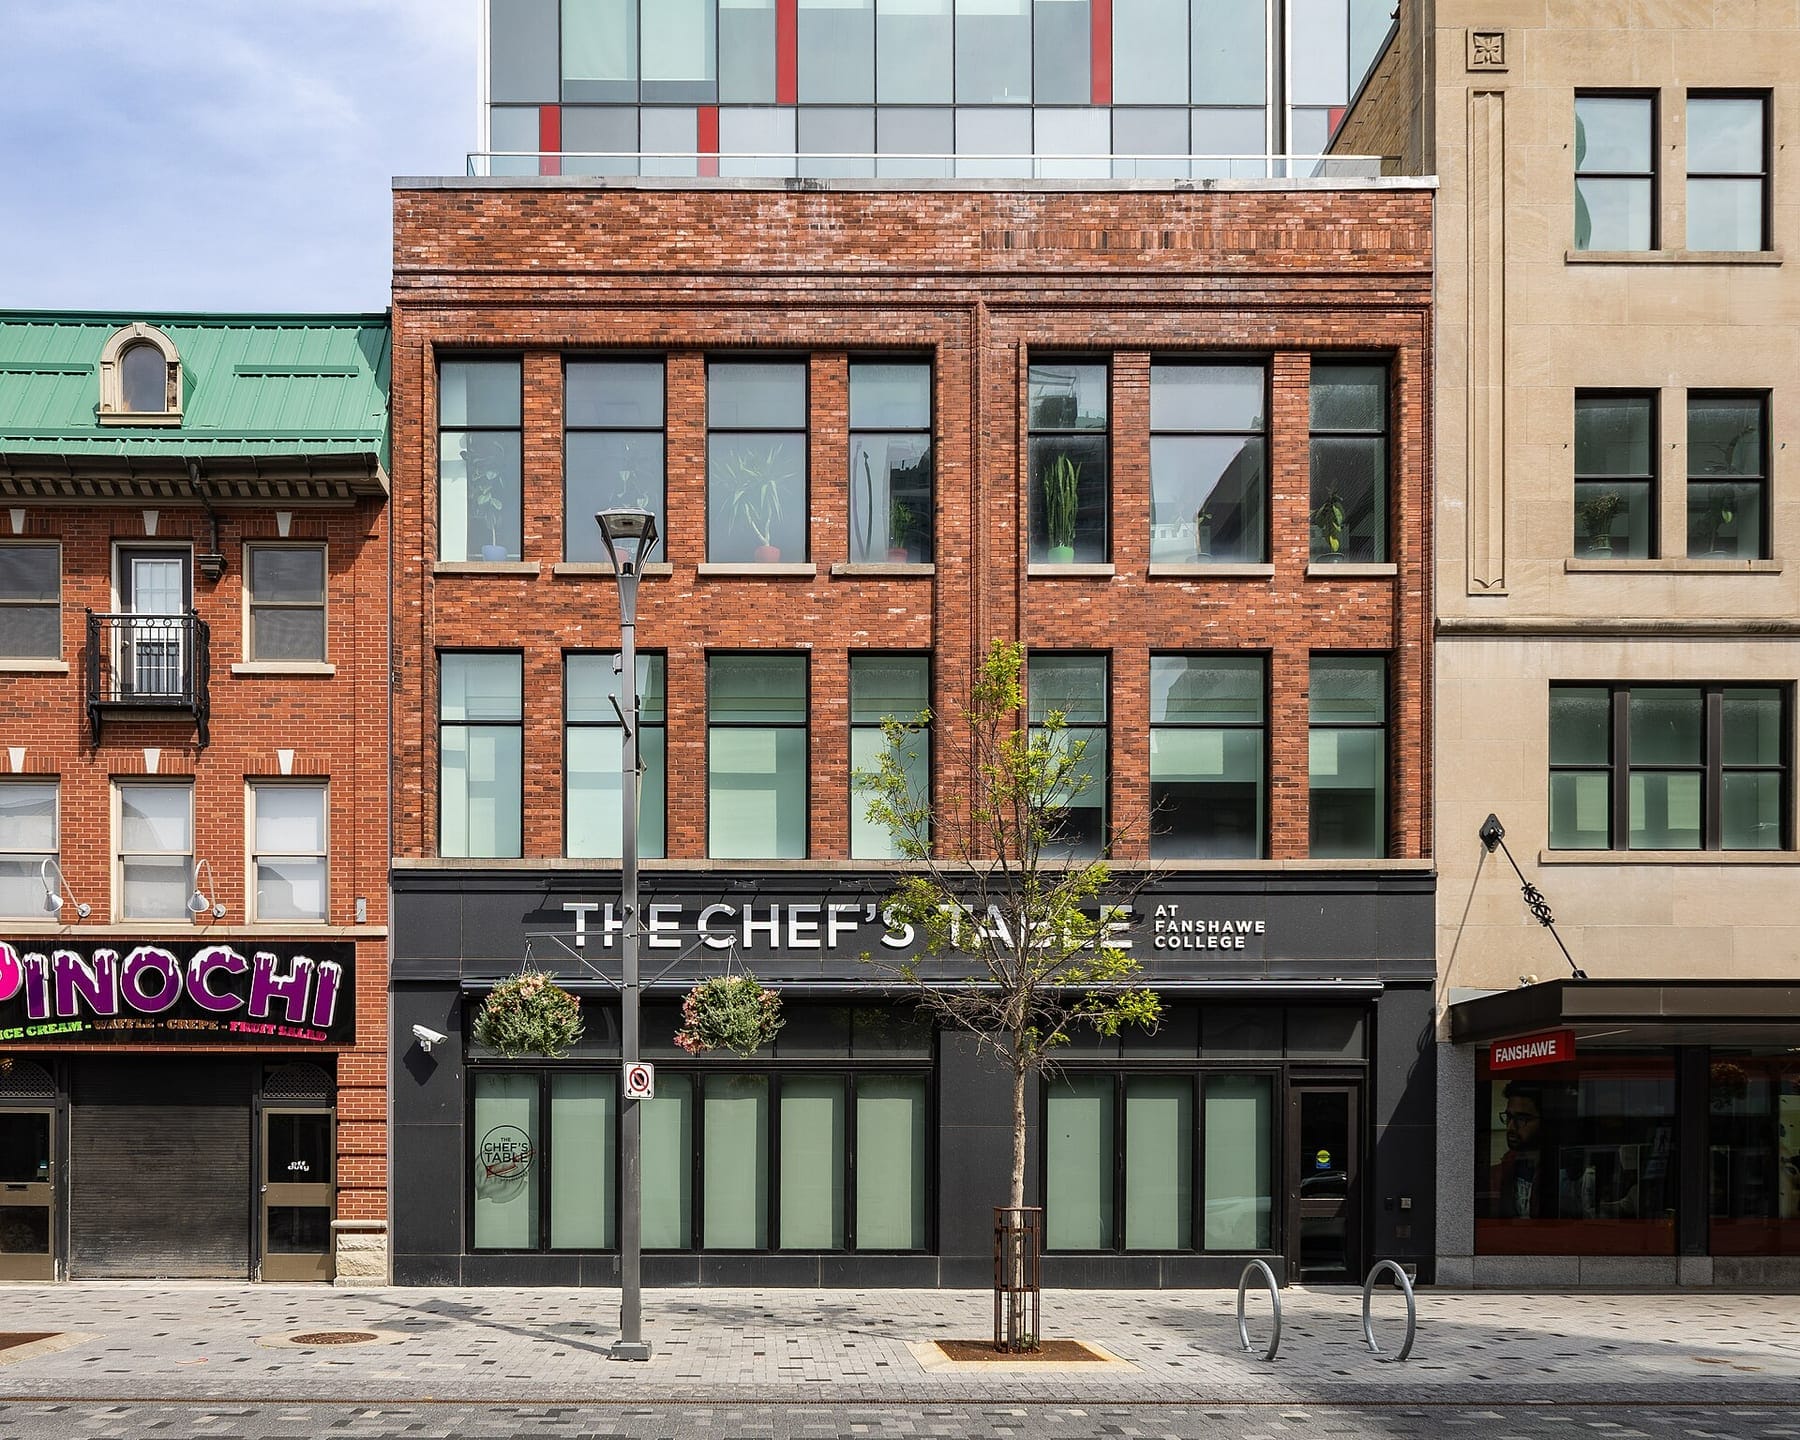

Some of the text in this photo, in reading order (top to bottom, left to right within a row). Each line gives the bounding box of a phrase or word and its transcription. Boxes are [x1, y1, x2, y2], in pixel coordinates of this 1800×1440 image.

[1155, 904, 1179, 917] AT
[563, 902, 682, 947] THE
[697, 902, 915, 947] CHEF'S
[1155, 920, 1266, 933] FANSHAWE
[1154, 935, 1245, 948] COLLEGE
[26, 1021, 83, 1037] CREAM
[94, 1018, 155, 1030] WAFFLE
[166, 1019, 219, 1030] CREPE
[229, 1021, 276, 1035] FRUIT
[278, 1025, 327, 1041] SALAD
[1495, 1039, 1557, 1063] FANSHAWE
[484, 1143, 529, 1152] CHEF'S
[484, 1152, 529, 1163] TABLE
